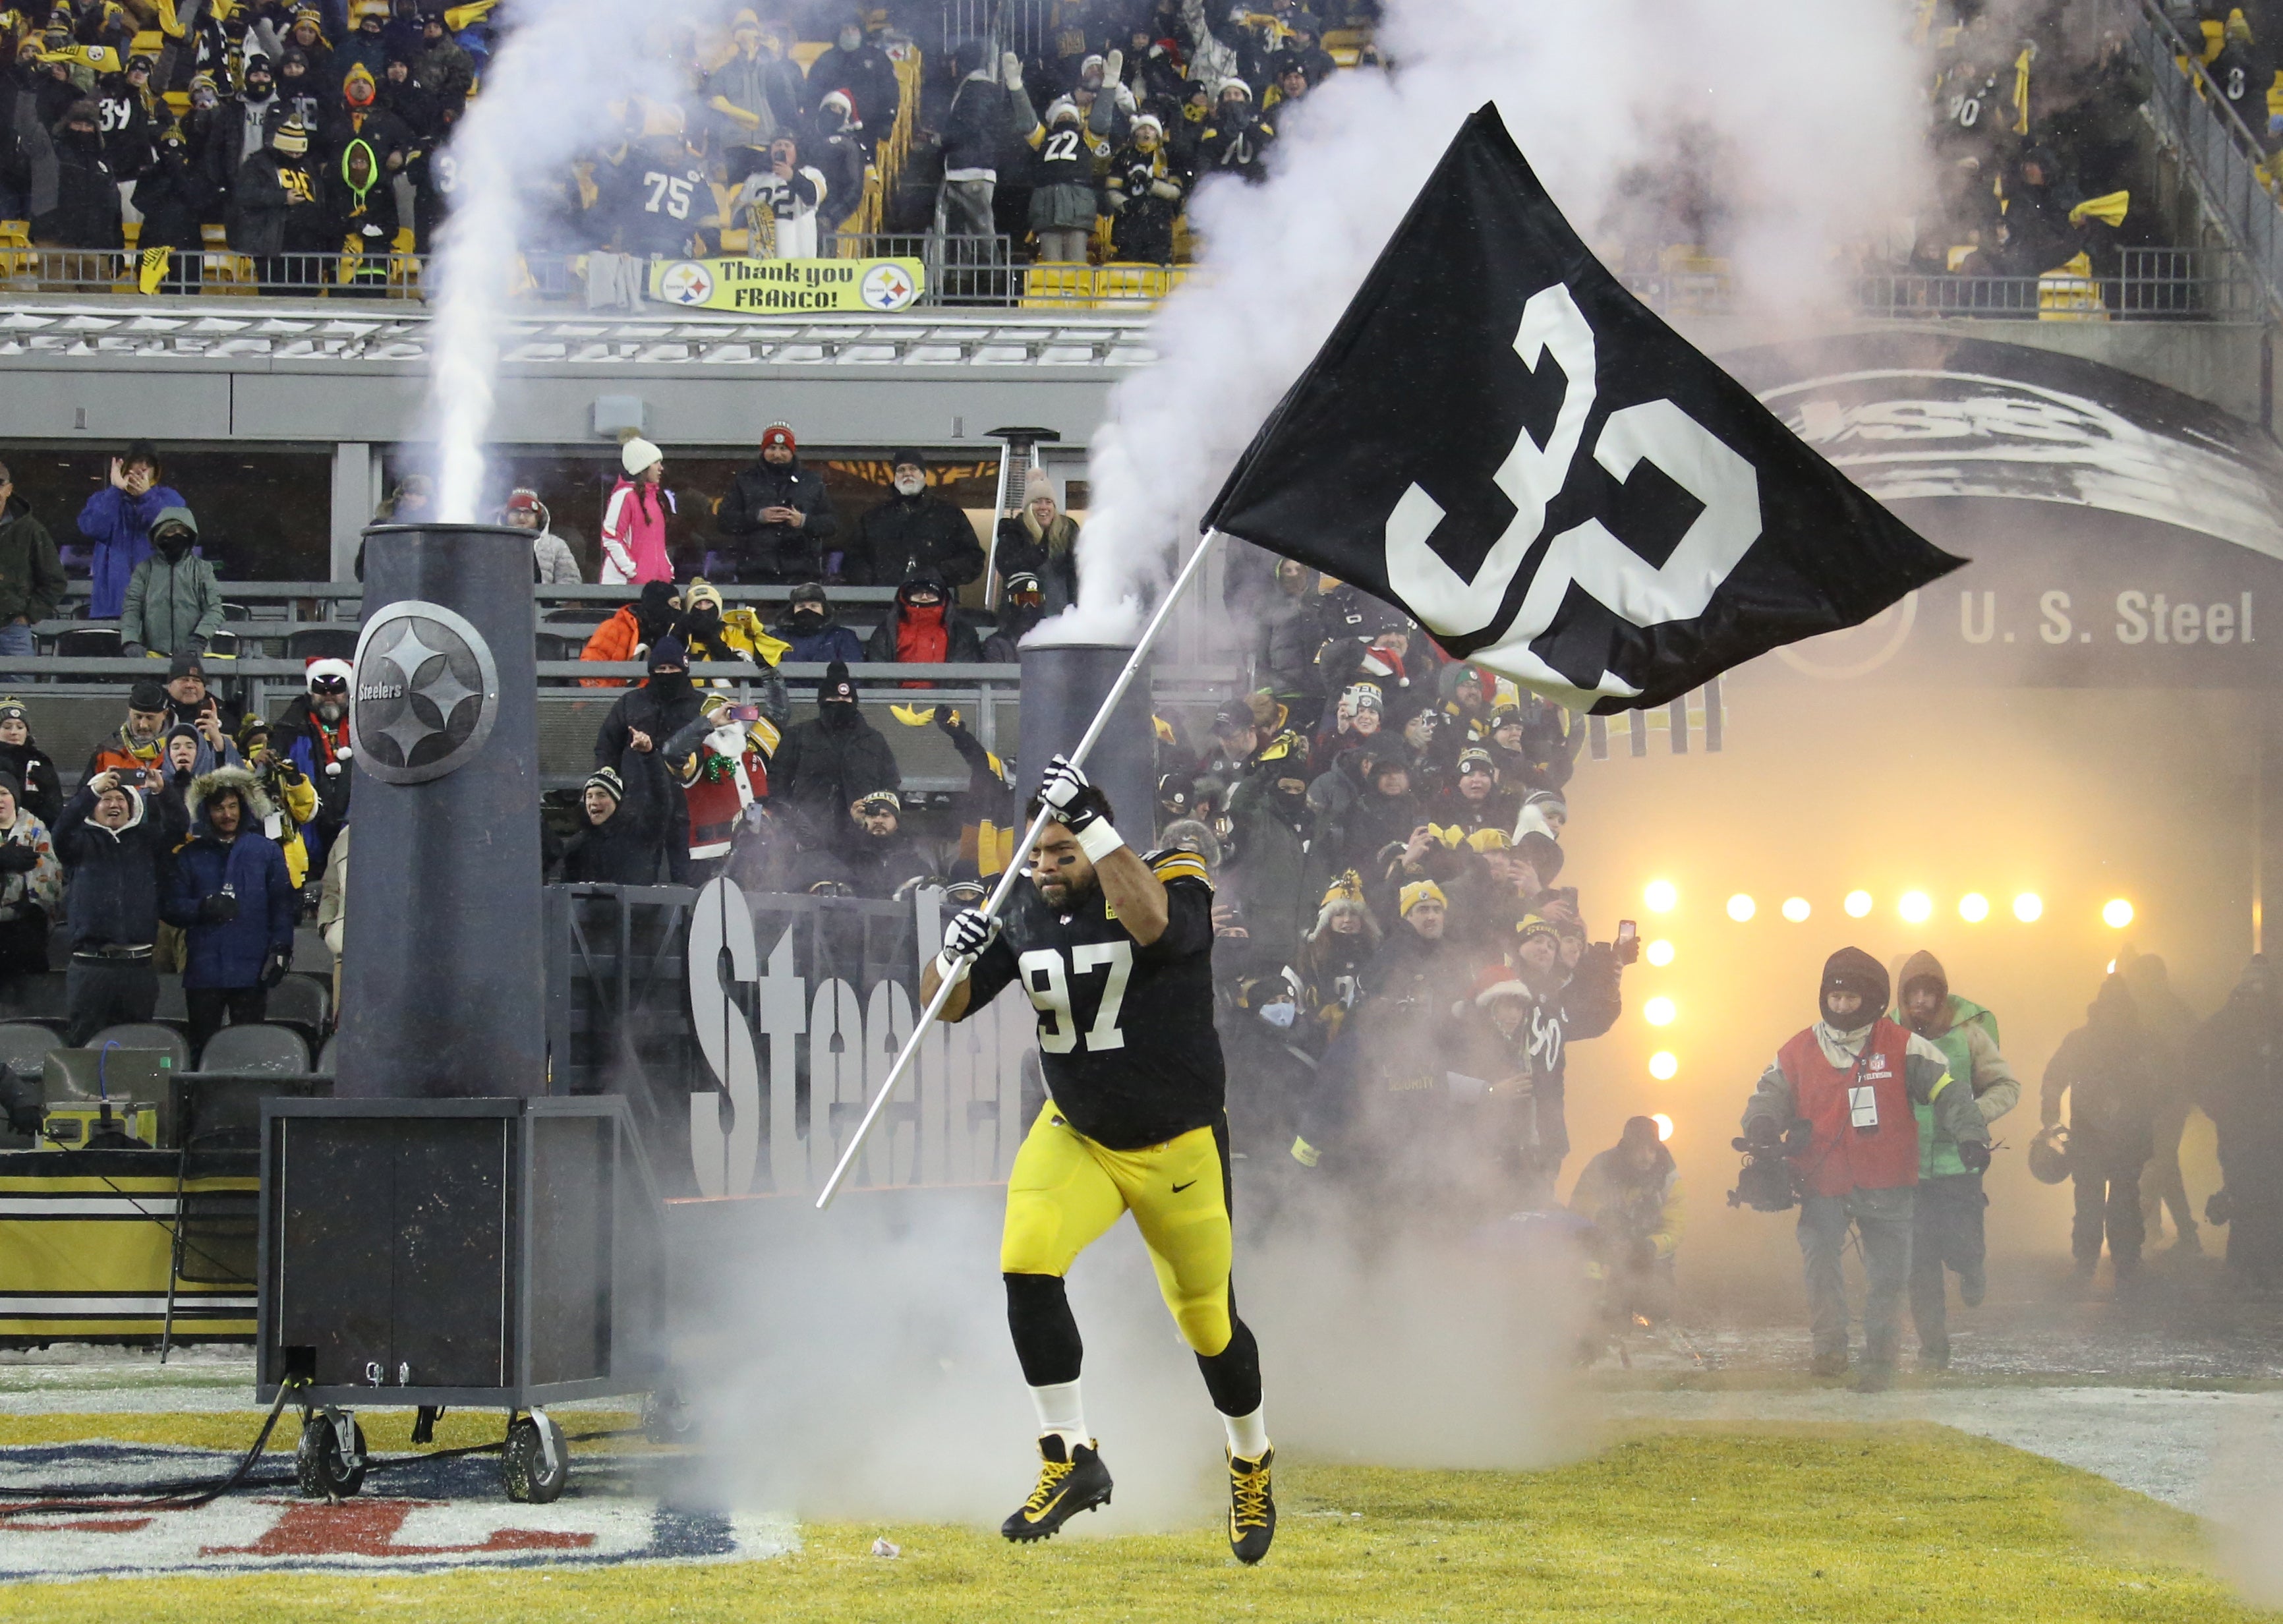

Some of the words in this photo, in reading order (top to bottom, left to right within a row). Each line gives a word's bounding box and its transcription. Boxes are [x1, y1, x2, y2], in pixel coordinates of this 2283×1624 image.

[100, 98, 131, 132] 39
[1045, 130, 1079, 162] 22
[643, 171, 693, 221] 75
[720, 262, 799, 283] Thank
[806, 268, 853, 287] you
[734, 288, 838, 308] FRANCO!
[1961, 591, 2015, 644] U.
[2039, 590, 2091, 645] S.
[2116, 589, 2253, 645] Steel
[359, 681, 402, 702] Steelers
[1018, 941, 1134, 1054] 97
[689, 877, 1053, 1197] Steeler
